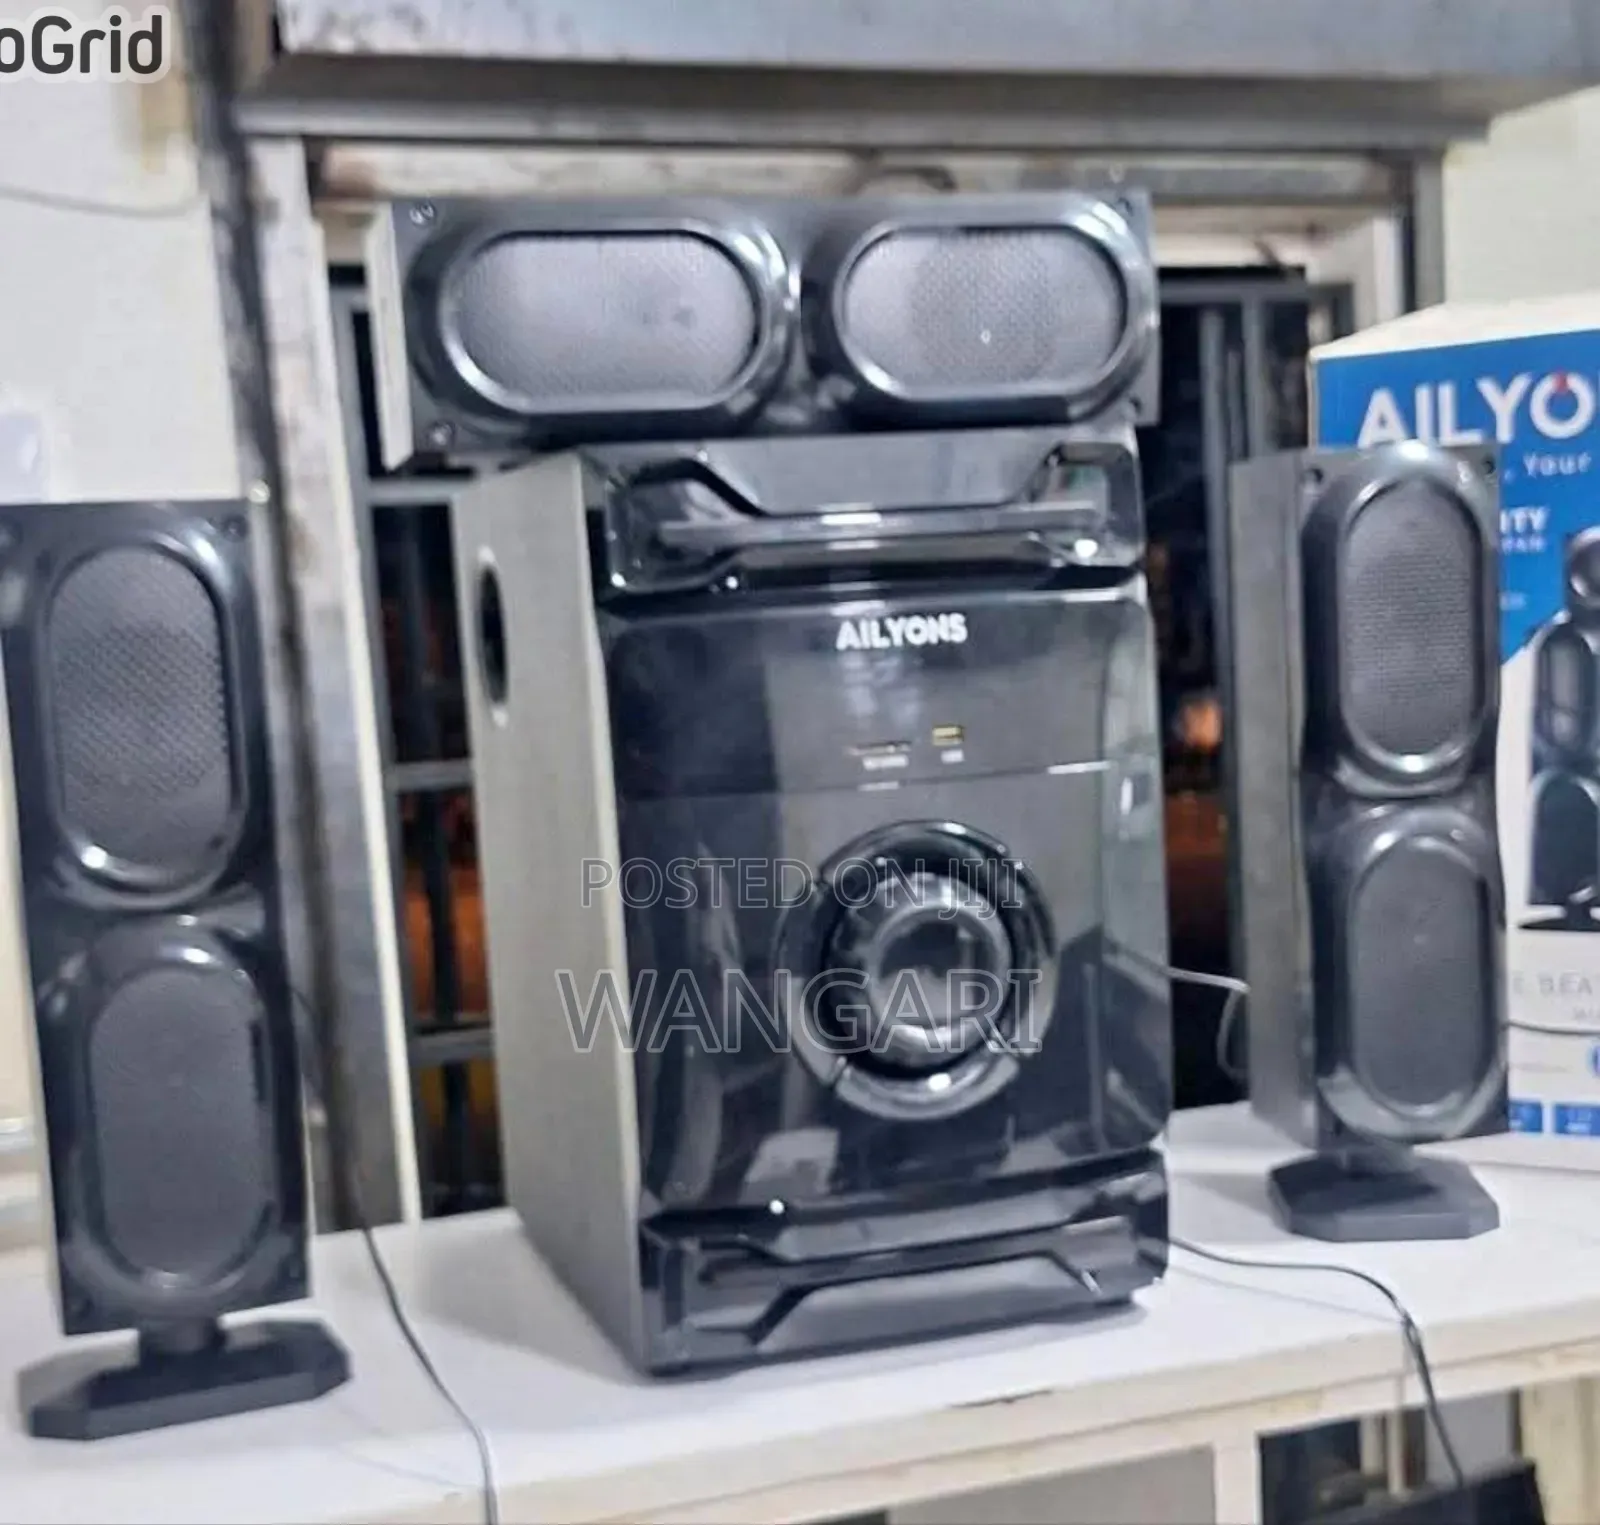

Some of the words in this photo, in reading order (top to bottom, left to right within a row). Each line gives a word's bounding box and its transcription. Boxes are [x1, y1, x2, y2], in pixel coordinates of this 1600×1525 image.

[1357, 371, 1600, 450] AILYO
[836, 612, 968, 651] AILYONS
[1539, 971, 1600, 996] BEA
